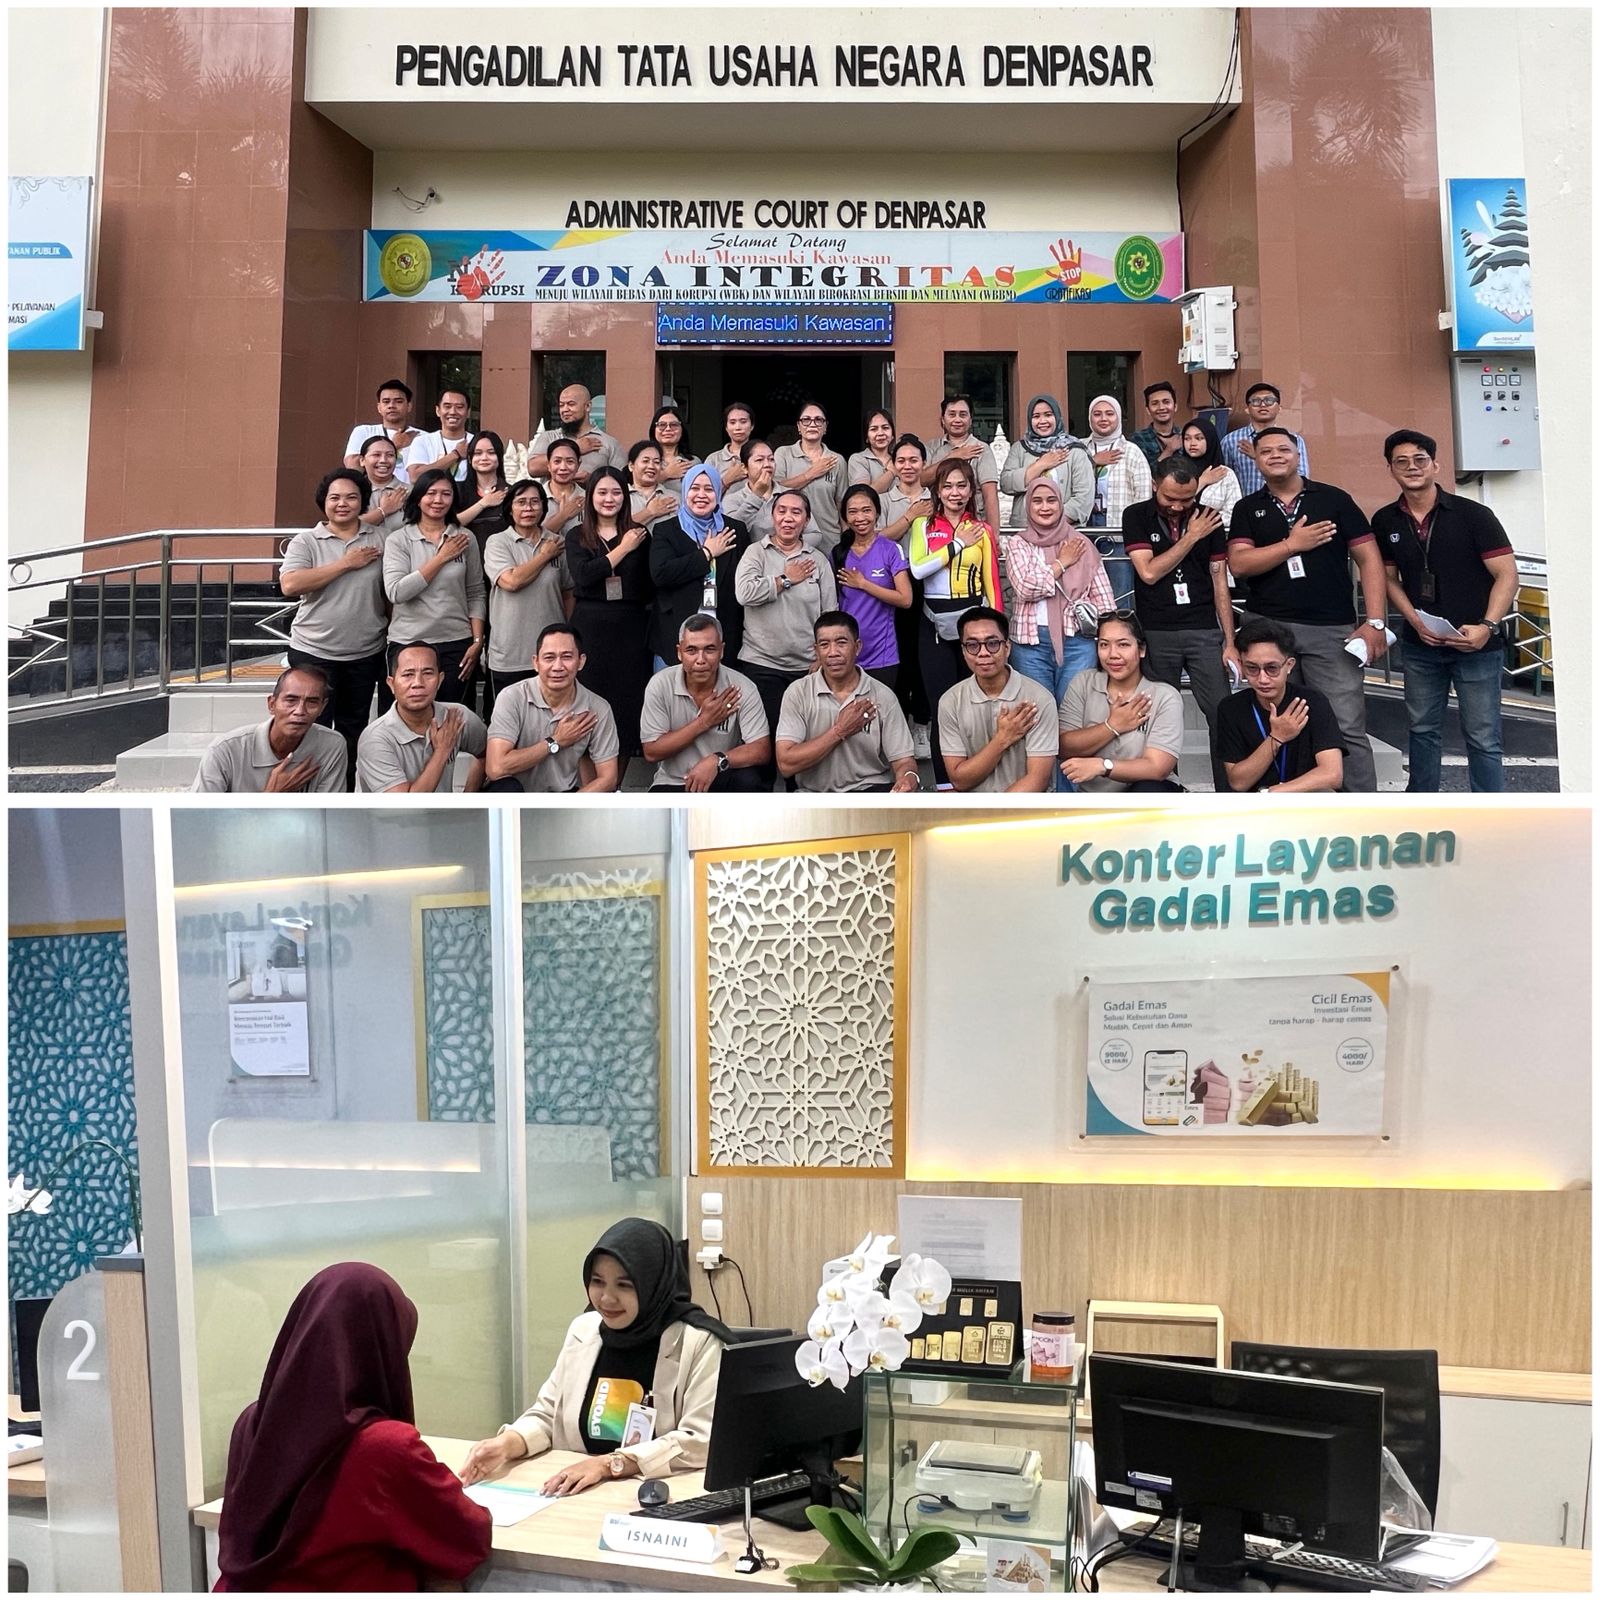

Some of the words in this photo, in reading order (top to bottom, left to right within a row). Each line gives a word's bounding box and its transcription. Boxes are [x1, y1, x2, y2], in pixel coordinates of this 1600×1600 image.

[396, 45, 601, 87] PENGADILAN
[617, 44, 692, 87] TATA
[709, 45, 818, 87] USAHA
[835, 45, 966, 87] NEGARA
[983, 45, 1154, 87] DENPASAR
[565, 200, 744, 229] ADMINISTRATIVE
[754, 200, 829, 229] COURT
[837, 200, 867, 229] OF
[875, 200, 987, 229] DENPASAR
[705, 232, 778, 251] Selamat
[786, 232, 847, 252] Datang
[32, 247, 61, 255] PUBLIK
[660, 249, 706, 265] Anda
[714, 249, 804, 265] Memasuki
[813, 249, 892, 265] Kawasan
[536, 265, 671, 288] ZONA
[690, 264, 1016, 288] INTEGRITAS
[1059, 266, 1083, 282] STOP
[450, 284, 525, 296] KRUPSI
[535, 289, 569, 301] MENUJU
[571, 289, 614, 300] WILAYAH
[616, 289, 647, 300] BEBAS
[649, 289, 673, 300] DARI
[675, 289, 717, 300] KORUPSI
[719, 289, 750, 301] (WBK)
[752, 289, 772, 300] DAN
[774, 289, 816, 300] WILAYAH
[818, 289, 871, 300] BIROKRASI
[873, 289, 908, 300] BERSIH
[910, 289, 930, 300] DAN
[932, 289, 977, 300] MELAYANI
[979, 289, 1017, 301] (WBBM)
[1044, 287, 1092, 300] GRATIFIKASI
[12, 303, 56, 311] PELAYANAN
[659, 314, 705, 331] Anda
[711, 313, 798, 331] Memasuki
[804, 314, 885, 331] Kawasan
[1061, 840, 1227, 882] Konter
[1234, 829, 1456, 882] Layanan
[1248, 881, 1396, 925] Emas
[1137, 1000, 1168, 1010] Emas
[1311, 993, 1337, 1004] Cicil
[1341, 993, 1373, 1003] Emas
[1313, 1006, 1349, 1014] Investasi
[1170, 1021, 1193, 1029] Aman
[1292, 1017, 1316, 1025] harap
[1322, 1016, 1345, 1024] harap
[63, 1319, 101, 1381] 2
[590, 1381, 610, 1436] BYOND
[627, 1529, 688, 1548] ISNAINI
